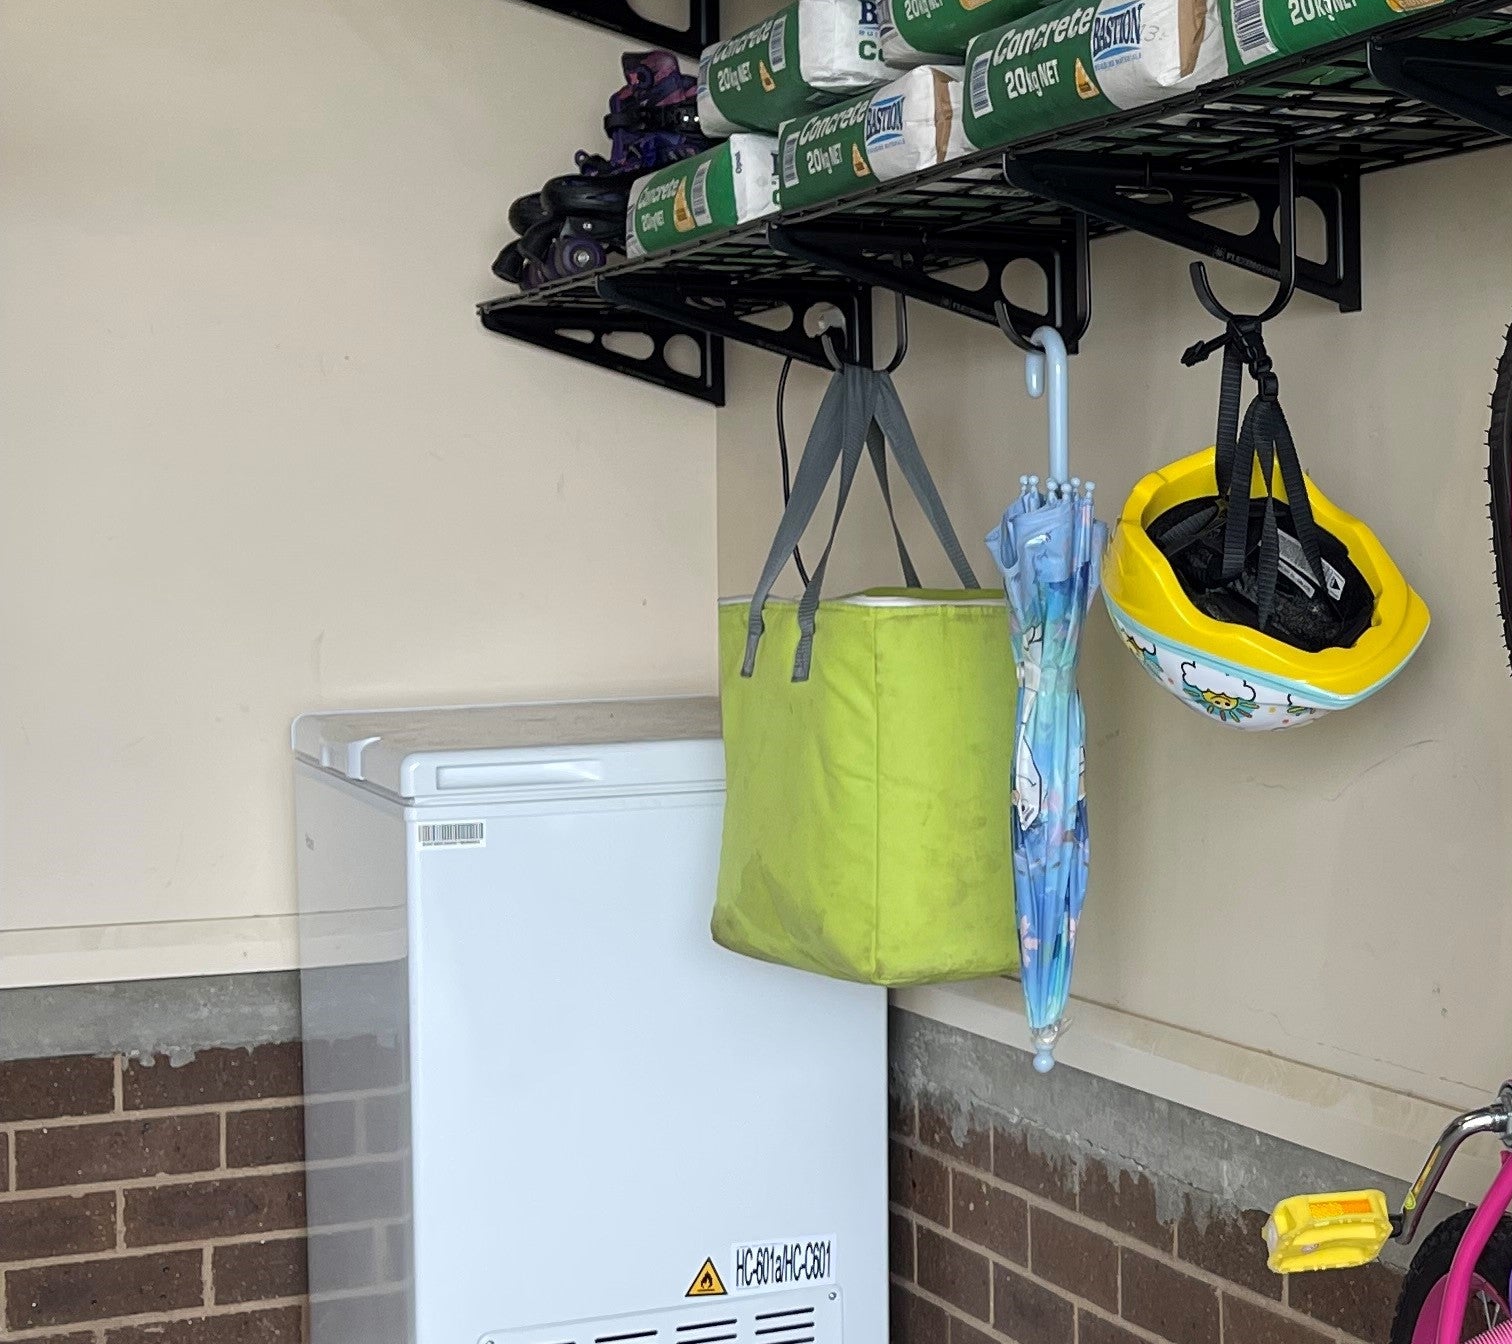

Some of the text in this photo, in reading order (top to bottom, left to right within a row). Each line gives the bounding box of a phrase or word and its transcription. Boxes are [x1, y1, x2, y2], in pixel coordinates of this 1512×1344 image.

[992, 6, 1095, 67] Concrete
[1093, 3, 1144, 58] BASTION
[1004, 66, 1043, 99] 20kg
[1038, 59, 1061, 88] NET
[799, 99, 870, 146] Concrete
